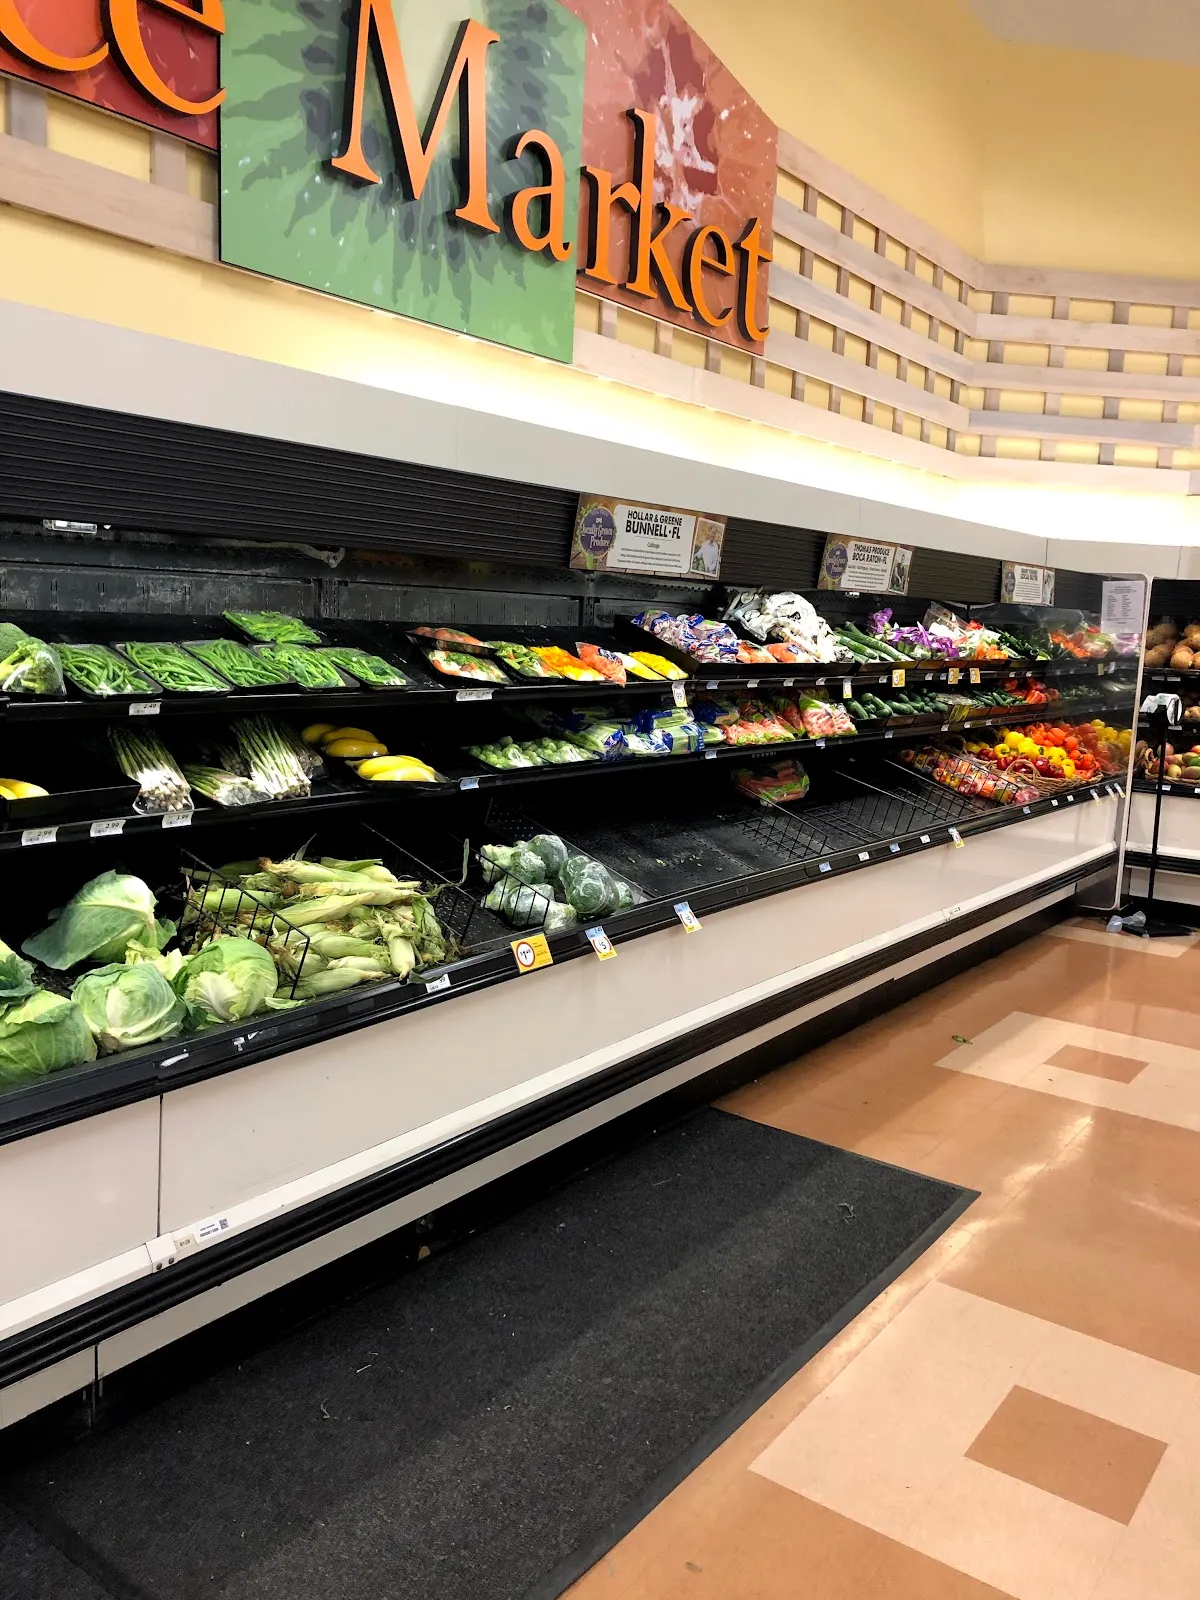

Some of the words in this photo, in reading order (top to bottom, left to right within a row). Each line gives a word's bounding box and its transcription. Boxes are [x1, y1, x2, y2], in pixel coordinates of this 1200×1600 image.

[330, 0, 775, 343] Market
[627, 509, 654, 523] HOLLAR
[654, 514, 659, 523] &
[660, 514, 683, 527] GREENE
[852, 552, 866, 562] BOCA
[853, 543, 872, 555] THOMAS
[872, 546, 890, 557] PRODUCE
[37, 829, 53, 837] 2.99
